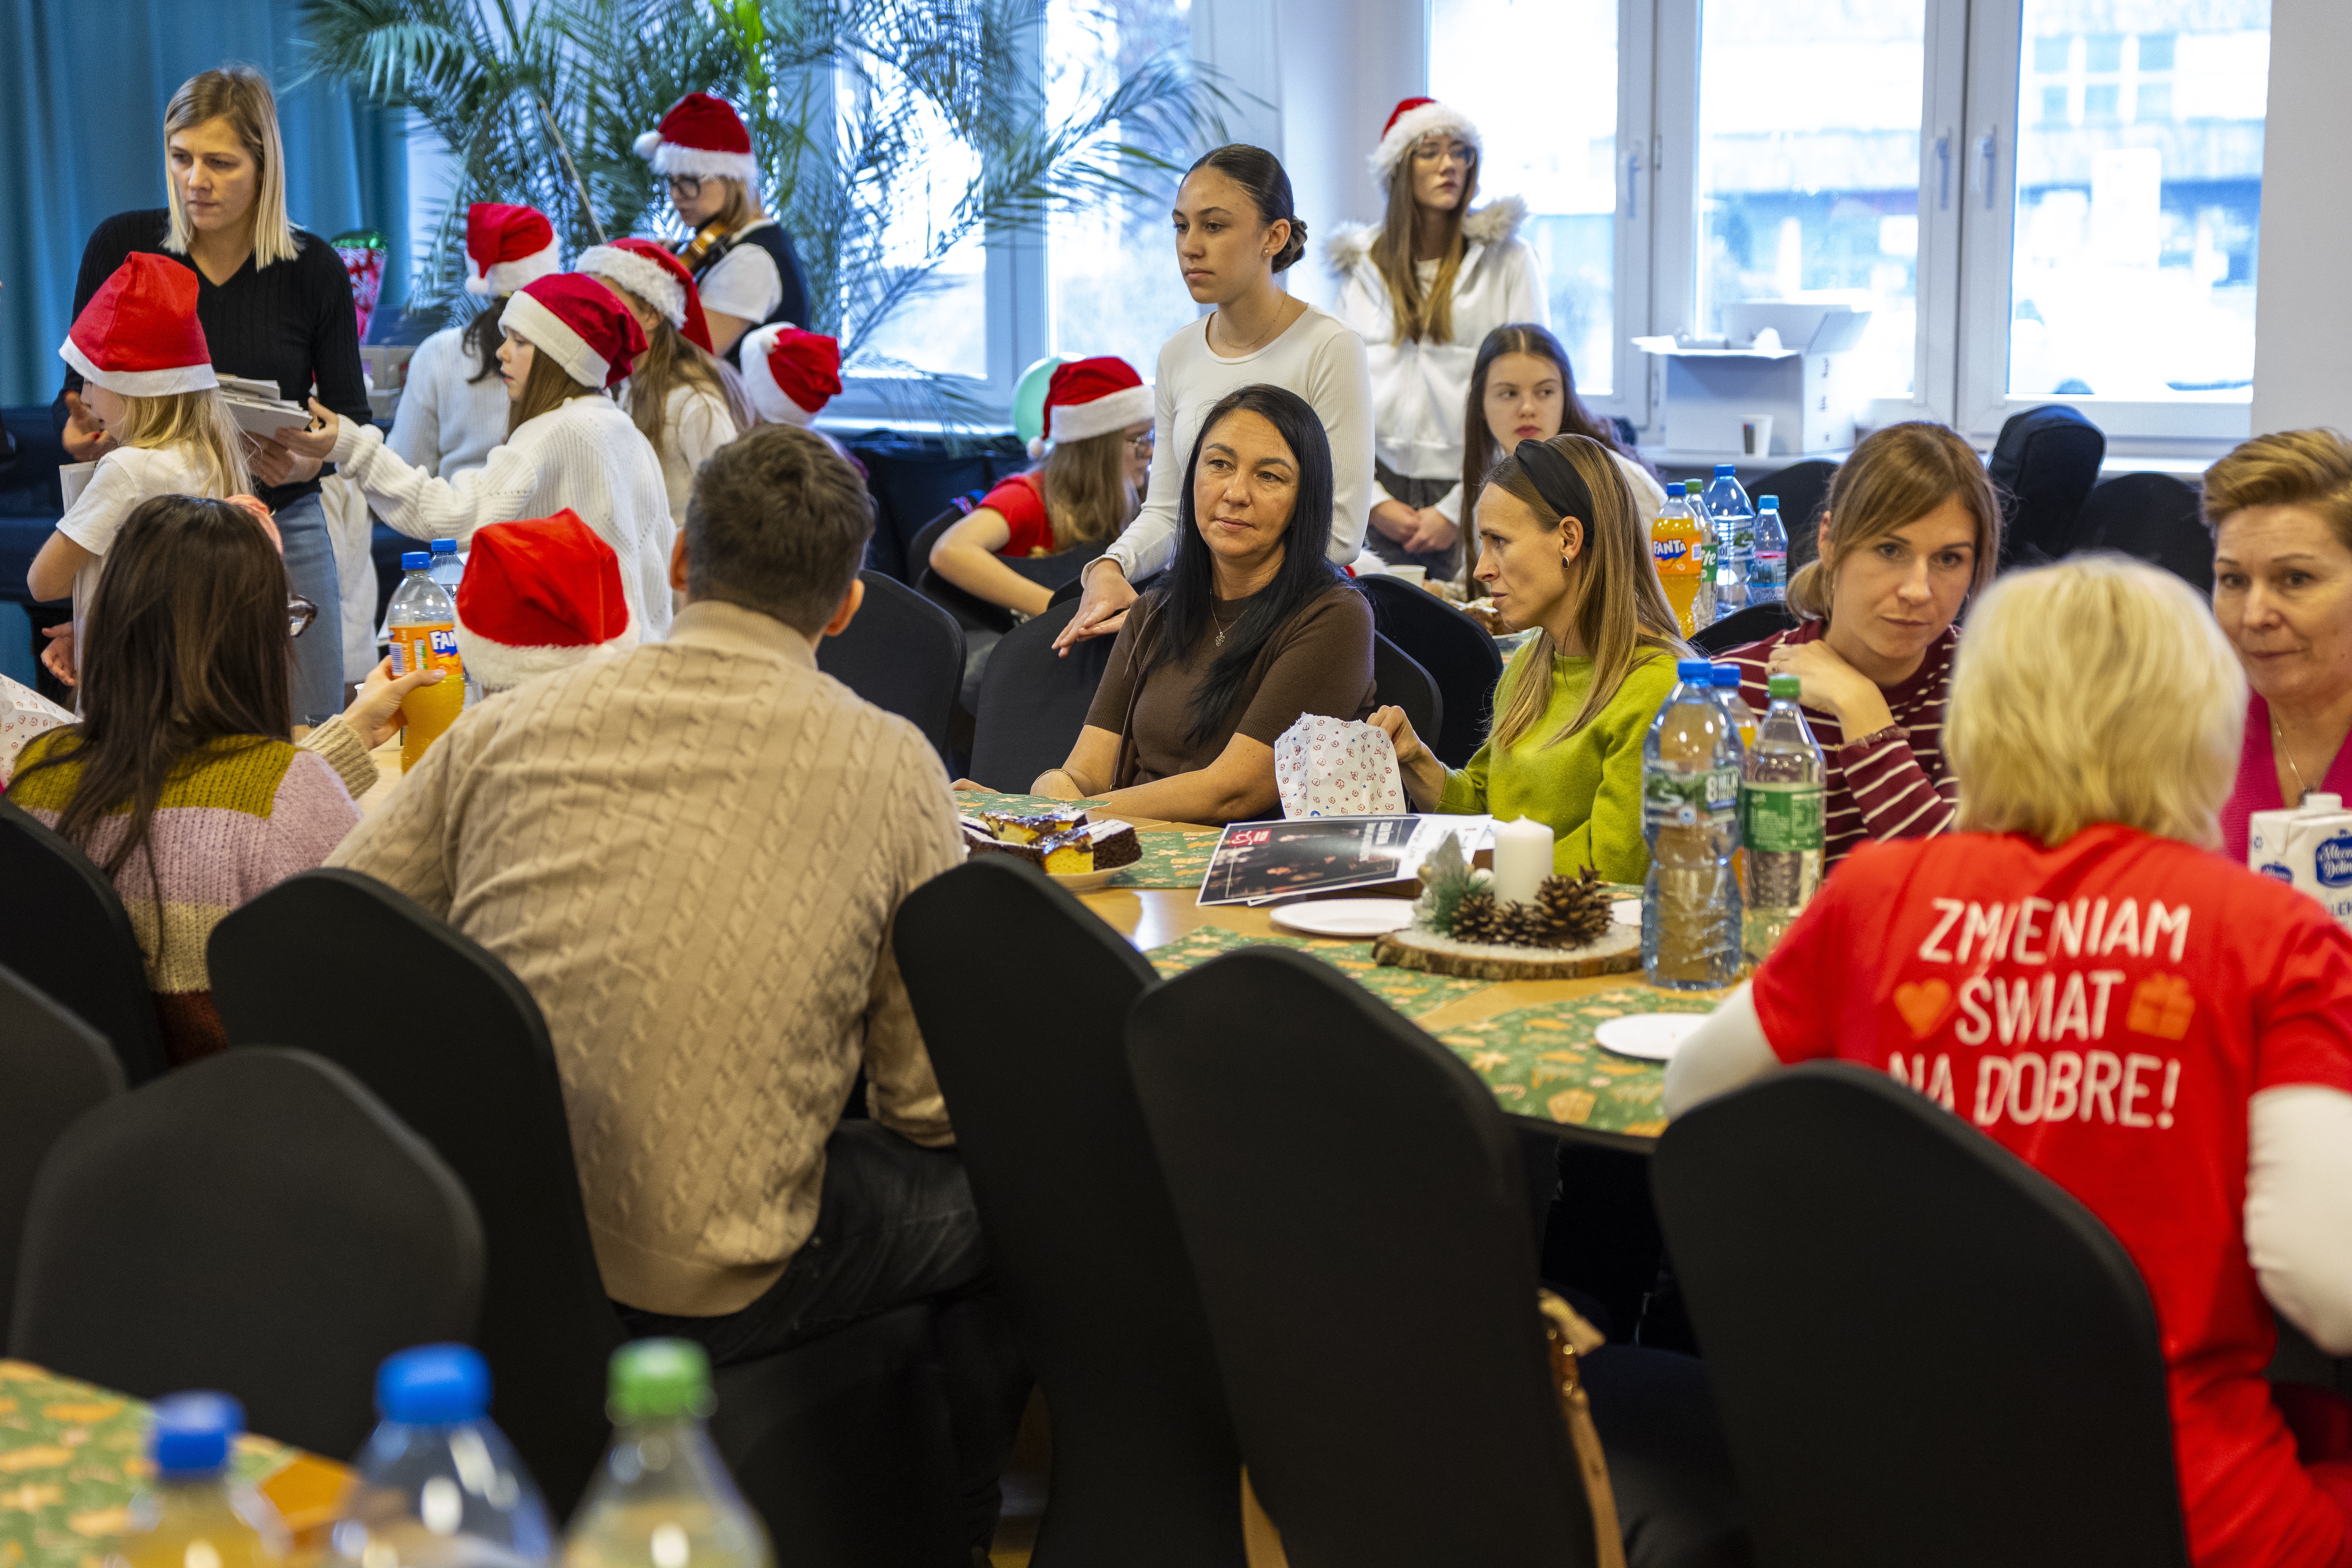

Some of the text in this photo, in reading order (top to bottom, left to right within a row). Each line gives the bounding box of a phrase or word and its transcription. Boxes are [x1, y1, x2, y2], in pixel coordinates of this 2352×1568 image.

[1653, 539, 1687, 555] FANTA
[1918, 896, 2191, 965] ZMIENIAM
[1954, 966, 2126, 1046] ŚWIAT
[1973, 1050, 2181, 1129] DOBRE!
